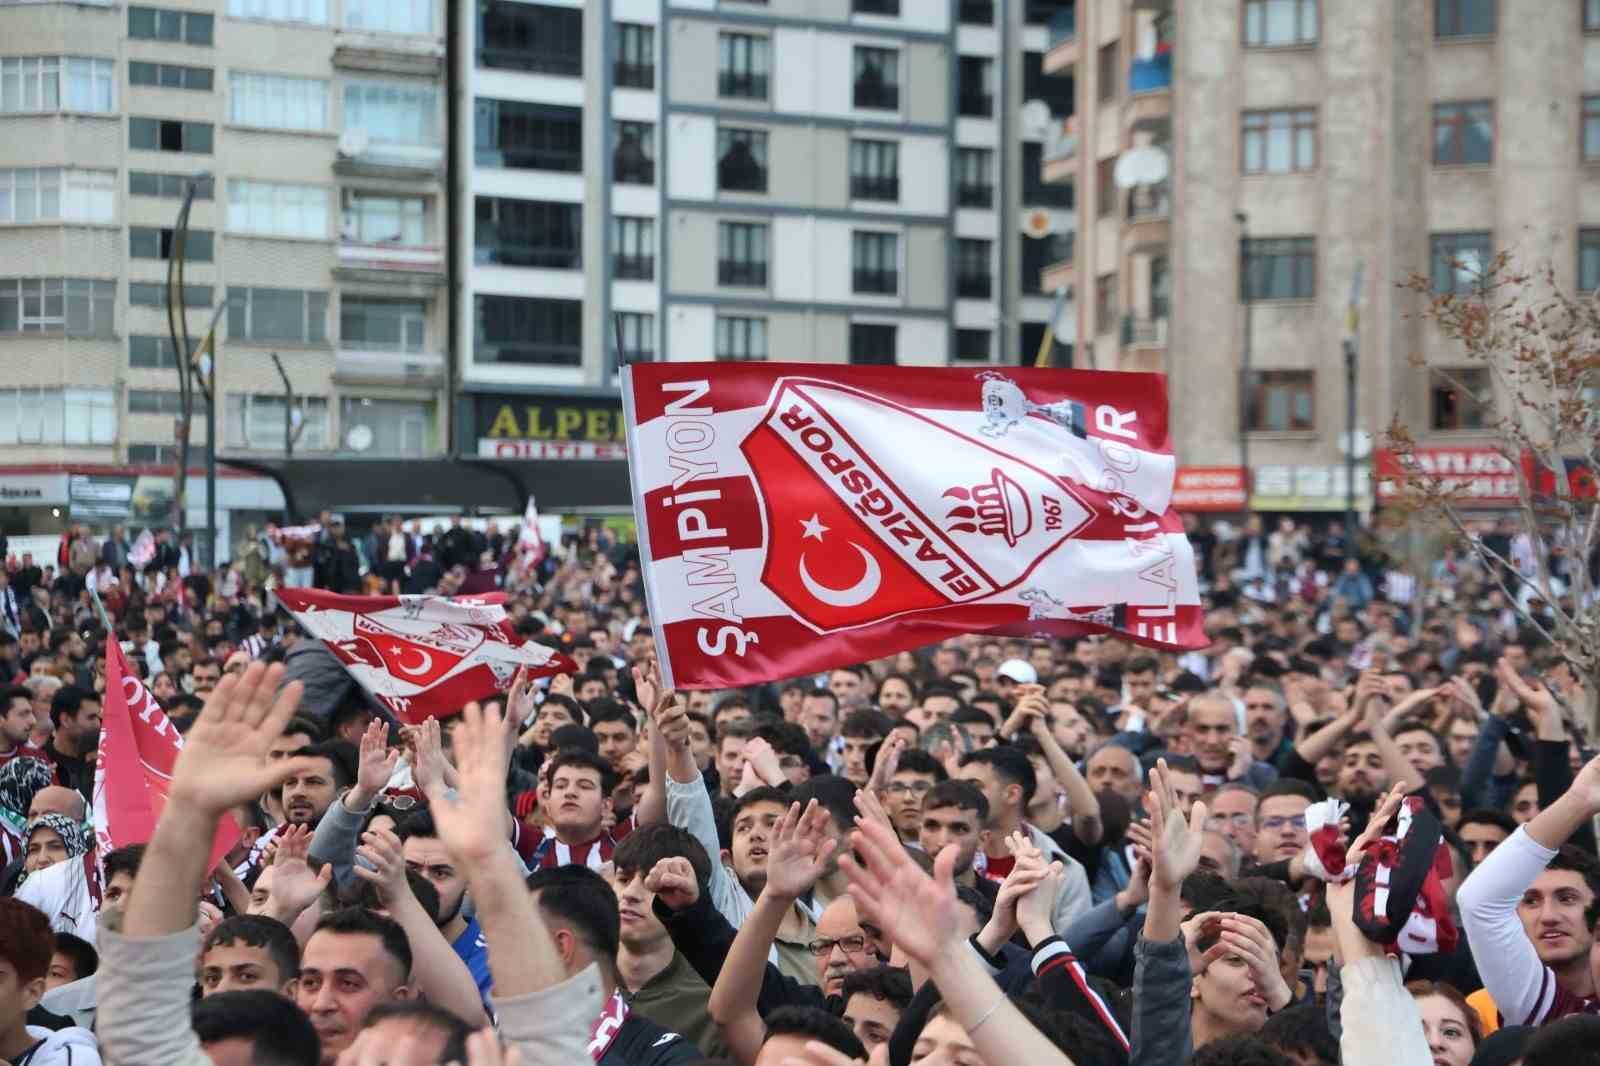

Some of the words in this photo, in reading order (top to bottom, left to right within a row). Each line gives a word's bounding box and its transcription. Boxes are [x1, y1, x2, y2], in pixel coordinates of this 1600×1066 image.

[496, 442, 628, 459] OUTLE
[780, 404, 982, 596] ELAZIĞSPOR
[661, 379, 759, 657] ŞAMPİYON
[1042, 495, 1062, 531] 1967
